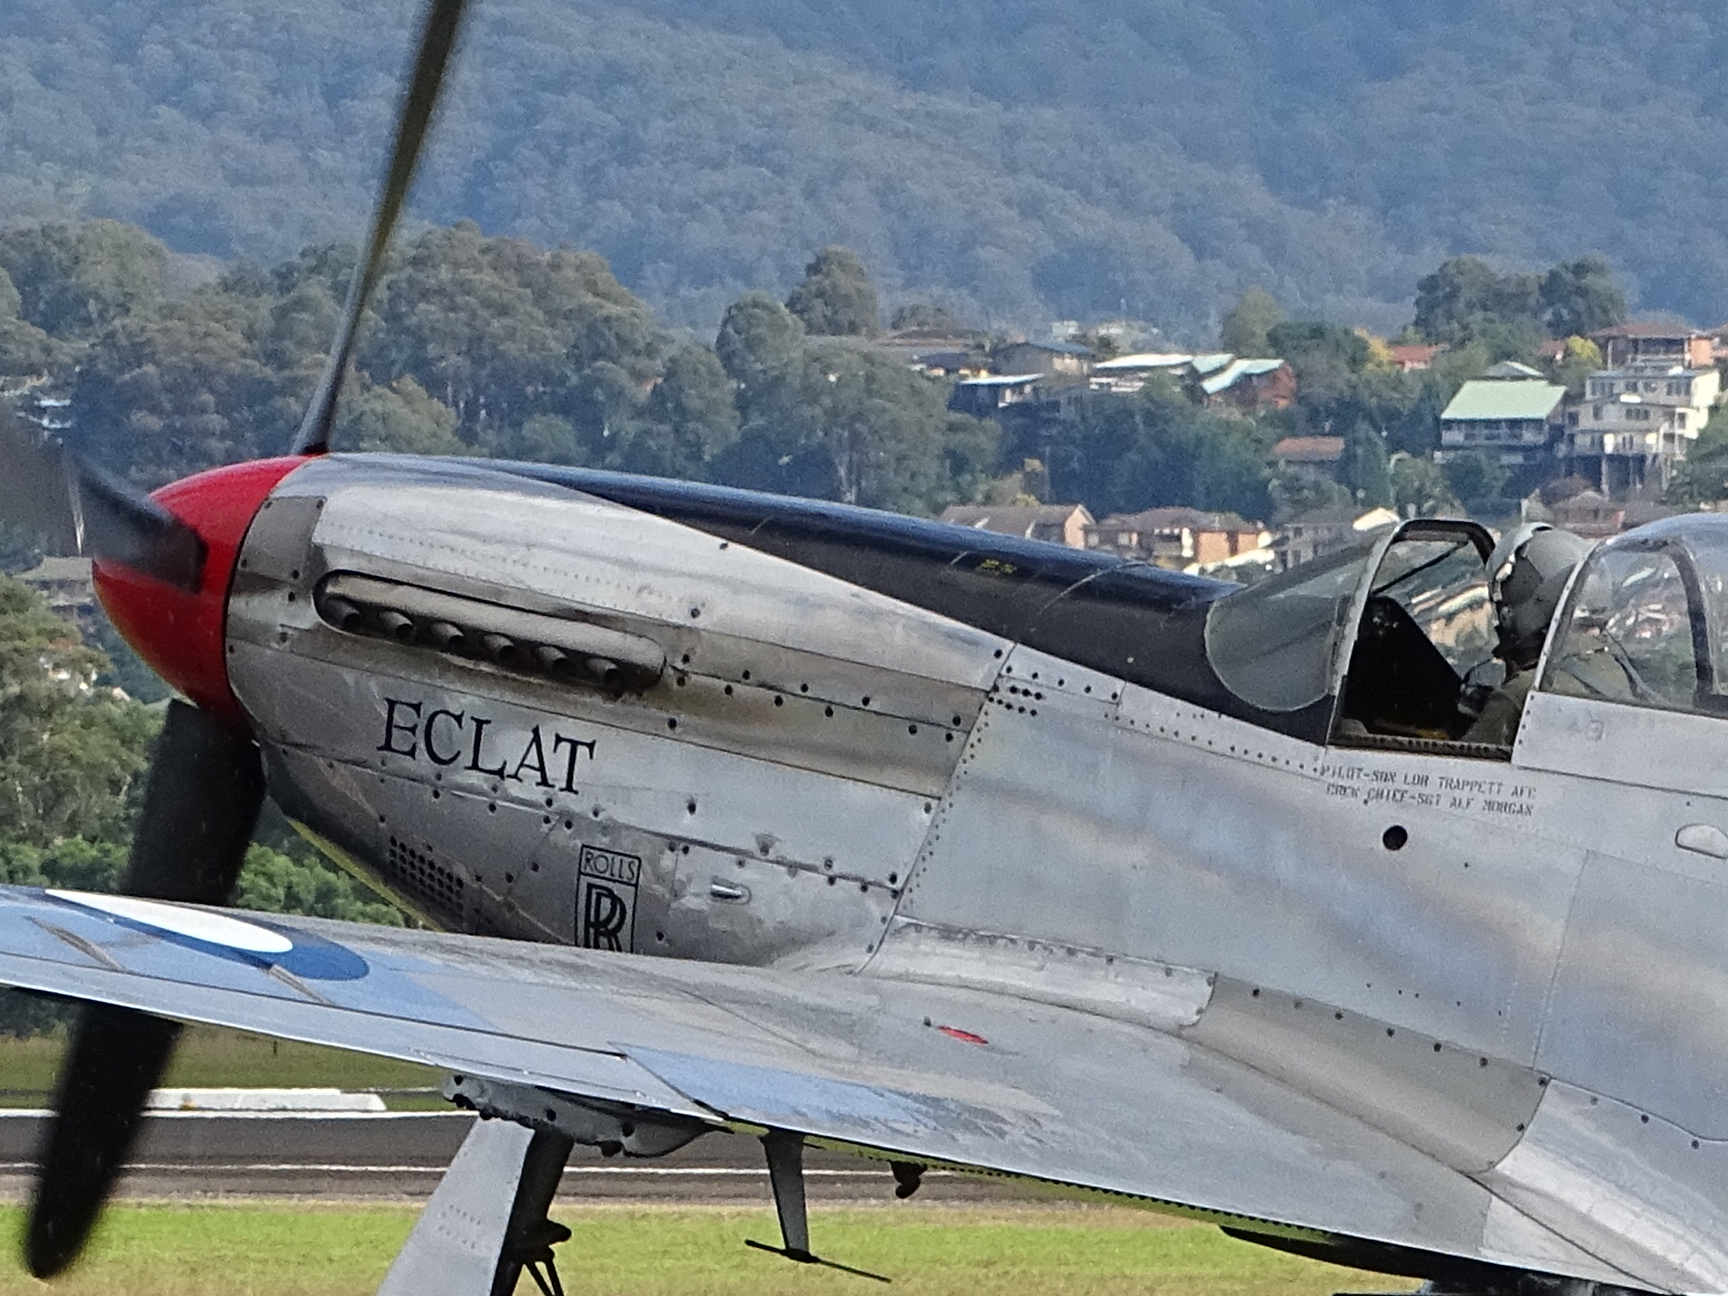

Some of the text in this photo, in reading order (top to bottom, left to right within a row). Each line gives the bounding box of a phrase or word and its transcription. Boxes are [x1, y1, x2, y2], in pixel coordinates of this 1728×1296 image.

[377, 698, 597, 795] ECLAT
[1438, 773, 1504, 796] TRAPPETT
[583, 850, 636, 882] ROLLS
